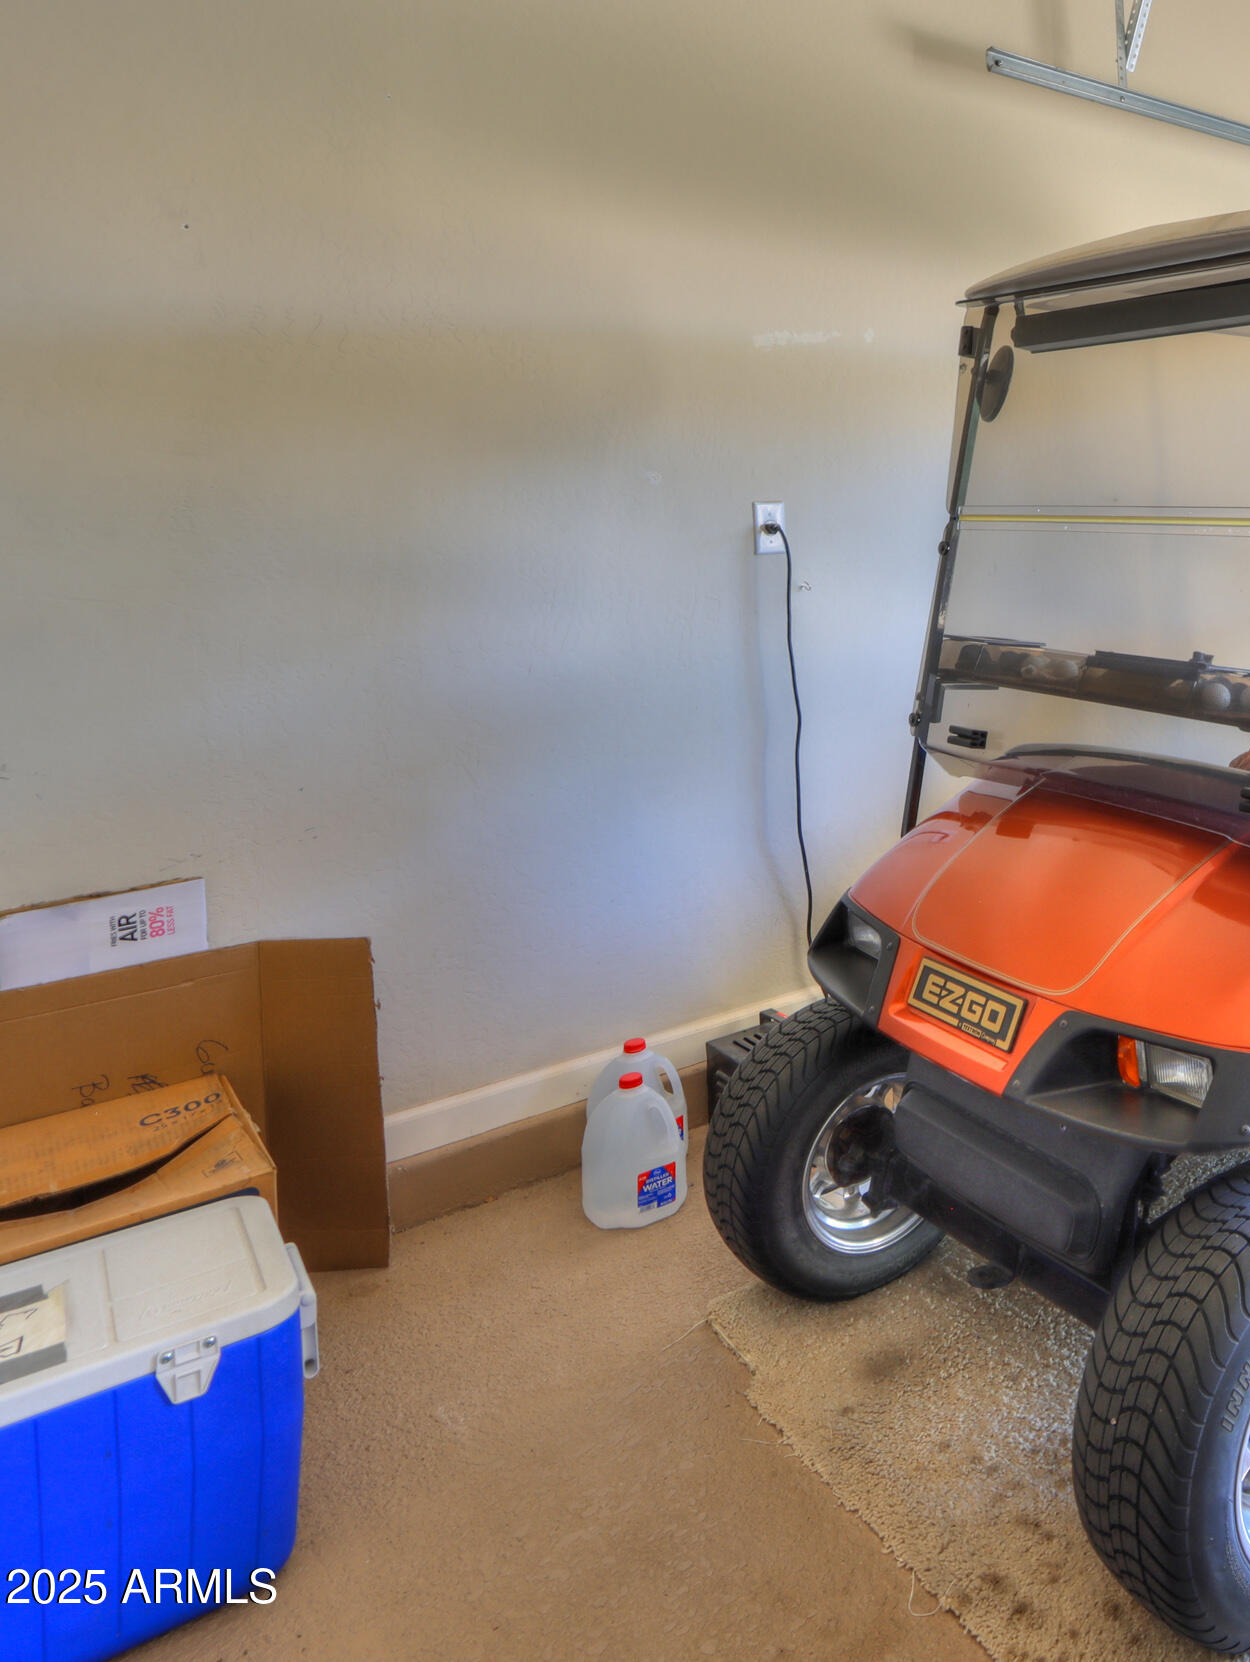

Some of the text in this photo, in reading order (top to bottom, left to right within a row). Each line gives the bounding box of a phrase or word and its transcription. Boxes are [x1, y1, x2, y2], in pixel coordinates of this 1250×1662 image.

[118, 912, 138, 941] AIR
[139, 909, 146, 919] TO
[148, 906, 166, 938] 80%
[165, 905, 176, 935] LESS FAT
[140, 928, 148, 941] FOR
[139, 1092, 221, 1127] C300
[643, 1176, 673, 1193] WATER
